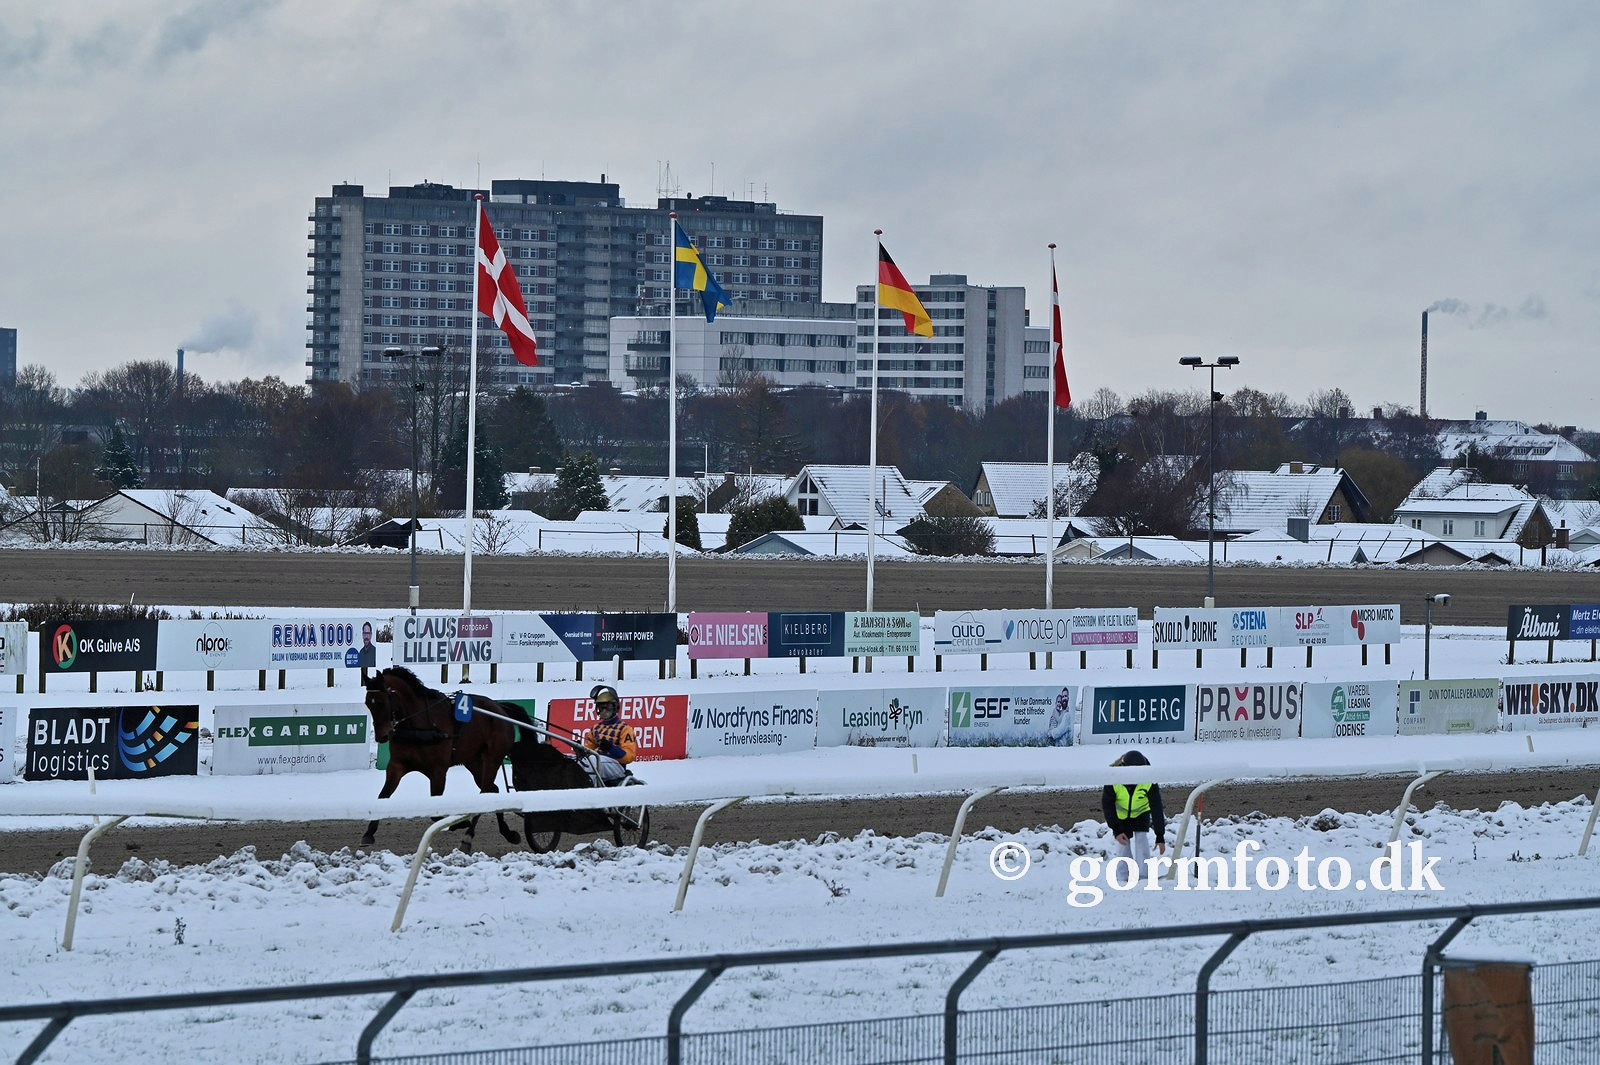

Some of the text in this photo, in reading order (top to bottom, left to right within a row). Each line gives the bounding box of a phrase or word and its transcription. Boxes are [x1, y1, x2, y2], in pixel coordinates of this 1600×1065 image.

[861, 617, 885, 628] HANSEN
[892, 617, 905, 628] SØN
[1240, 611, 1266, 630] STENA
[1296, 612, 1314, 629] SLP
[1358, 609, 1393, 621] MICRO MATIC
[1572, 610, 1590, 620] Mertz
[404, 618, 456, 639] CLAUS
[784, 624, 828, 635] KIELBERG
[952, 624, 984, 638] auto
[1017, 617, 1053, 640] mate
[1155, 621, 1217, 643] SKJOLD BURNE
[1517, 613, 1560, 638] Albani
[272, 624, 354, 648] REMA 1000
[528, 632, 546, 641] Gruppen
[602, 632, 654, 640] STEP PRINT POWER
[690, 624, 763, 646] OLE NIELSEN
[952, 638, 985, 646] centrum
[1232, 635, 1267, 645] RECYCLING
[80, 638, 140, 653] OK Gulve A/S
[404, 640, 492, 662] LILLEVANG
[309, 652, 318, 660] HANS
[1348, 685, 1370, 696] VAREBIL
[1429, 688, 1494, 699] DIN TOTALLEVERANDØR
[458, 695, 469, 714] 4
[974, 698, 1010, 718] SEF
[1029, 697, 1052, 705] Danmarks
[1348, 698, 1370, 708] LEASING
[1099, 698, 1180, 722] KIELBERG
[706, 705, 814, 732] Nordfyns Finans
[842, 706, 923, 731] Leasing Fyn
[34, 718, 110, 744] BLADT
[218, 727, 256, 738] FLEX
[1199, 726, 1280, 742] Ejendomme & Investering
[1336, 724, 1365, 736] ODENSE
[724, 730, 782, 746] Erhvervsleasing
[33, 750, 109, 777] logistics
[258, 754, 326, 766] www.flexgardin.dk
